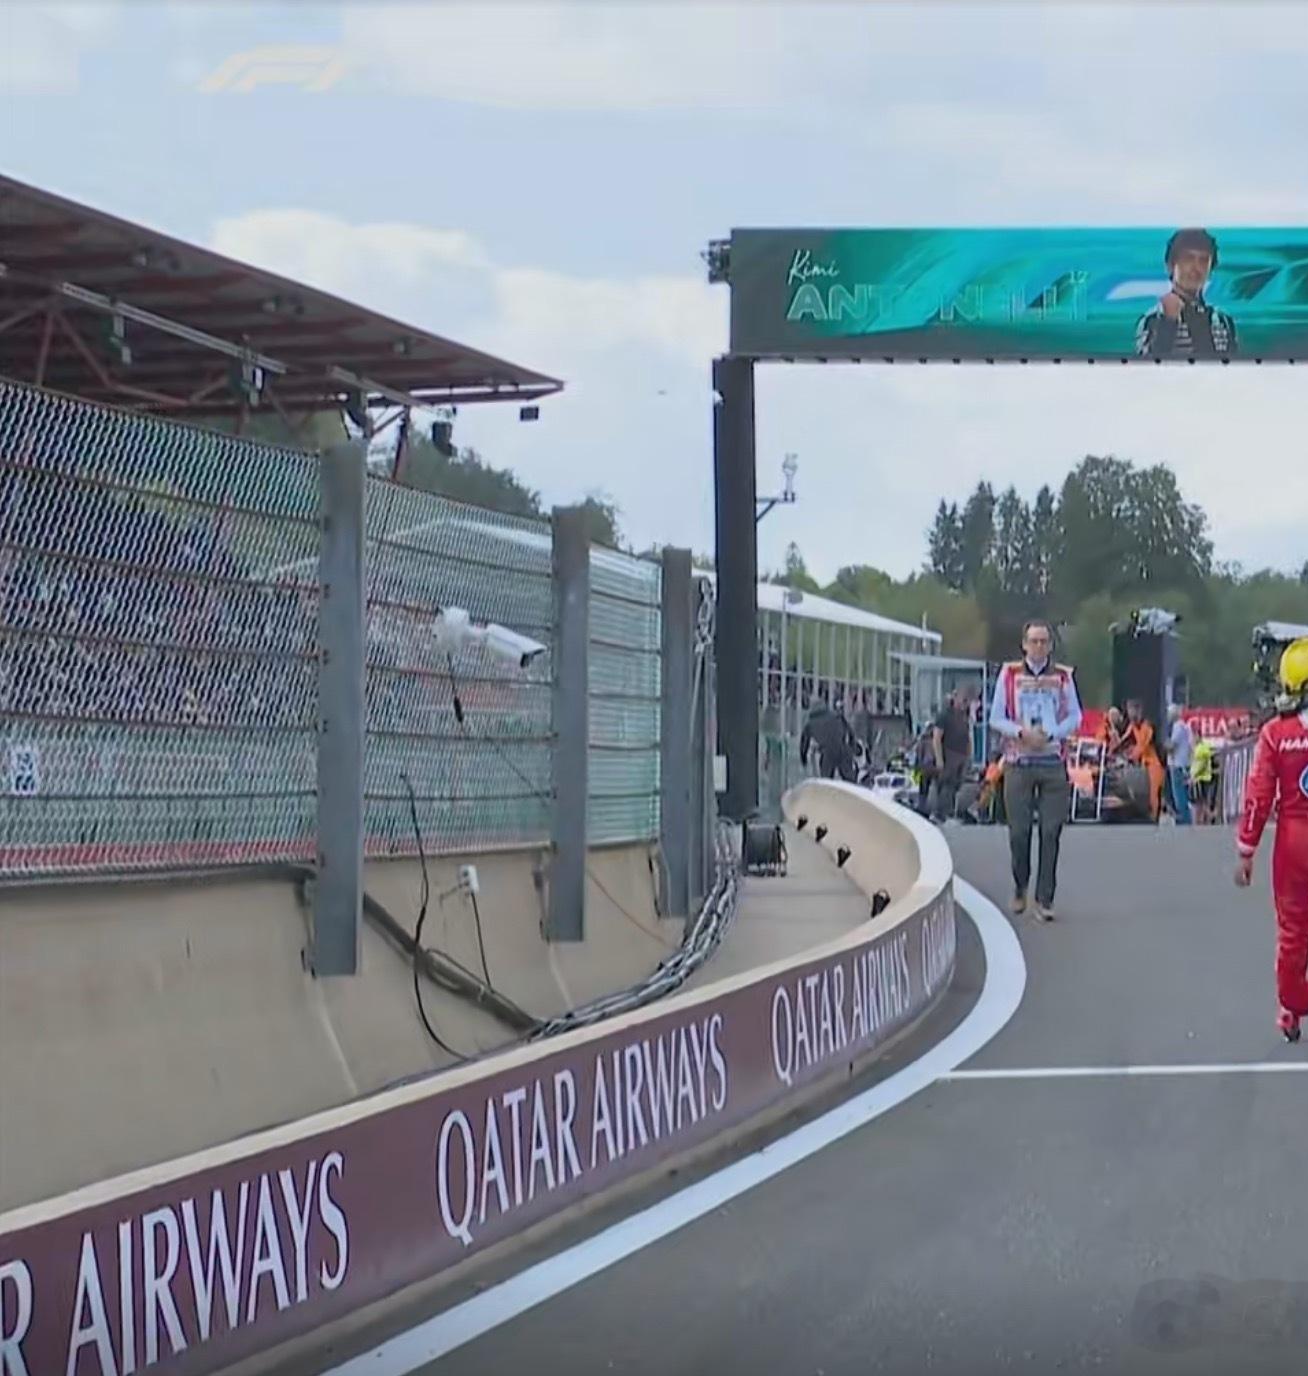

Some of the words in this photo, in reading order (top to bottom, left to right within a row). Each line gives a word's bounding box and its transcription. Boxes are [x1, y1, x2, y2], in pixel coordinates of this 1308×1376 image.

[787, 250, 840, 285] Kimi
[787, 283, 1088, 321] ANTNLLI
[772, 964, 848, 1087] QATAR
[437, 1068, 582, 1248] QATAR
[591, 1013, 727, 1169] AIRWAYS
[66, 1151, 348, 1376] AIRWAYS
